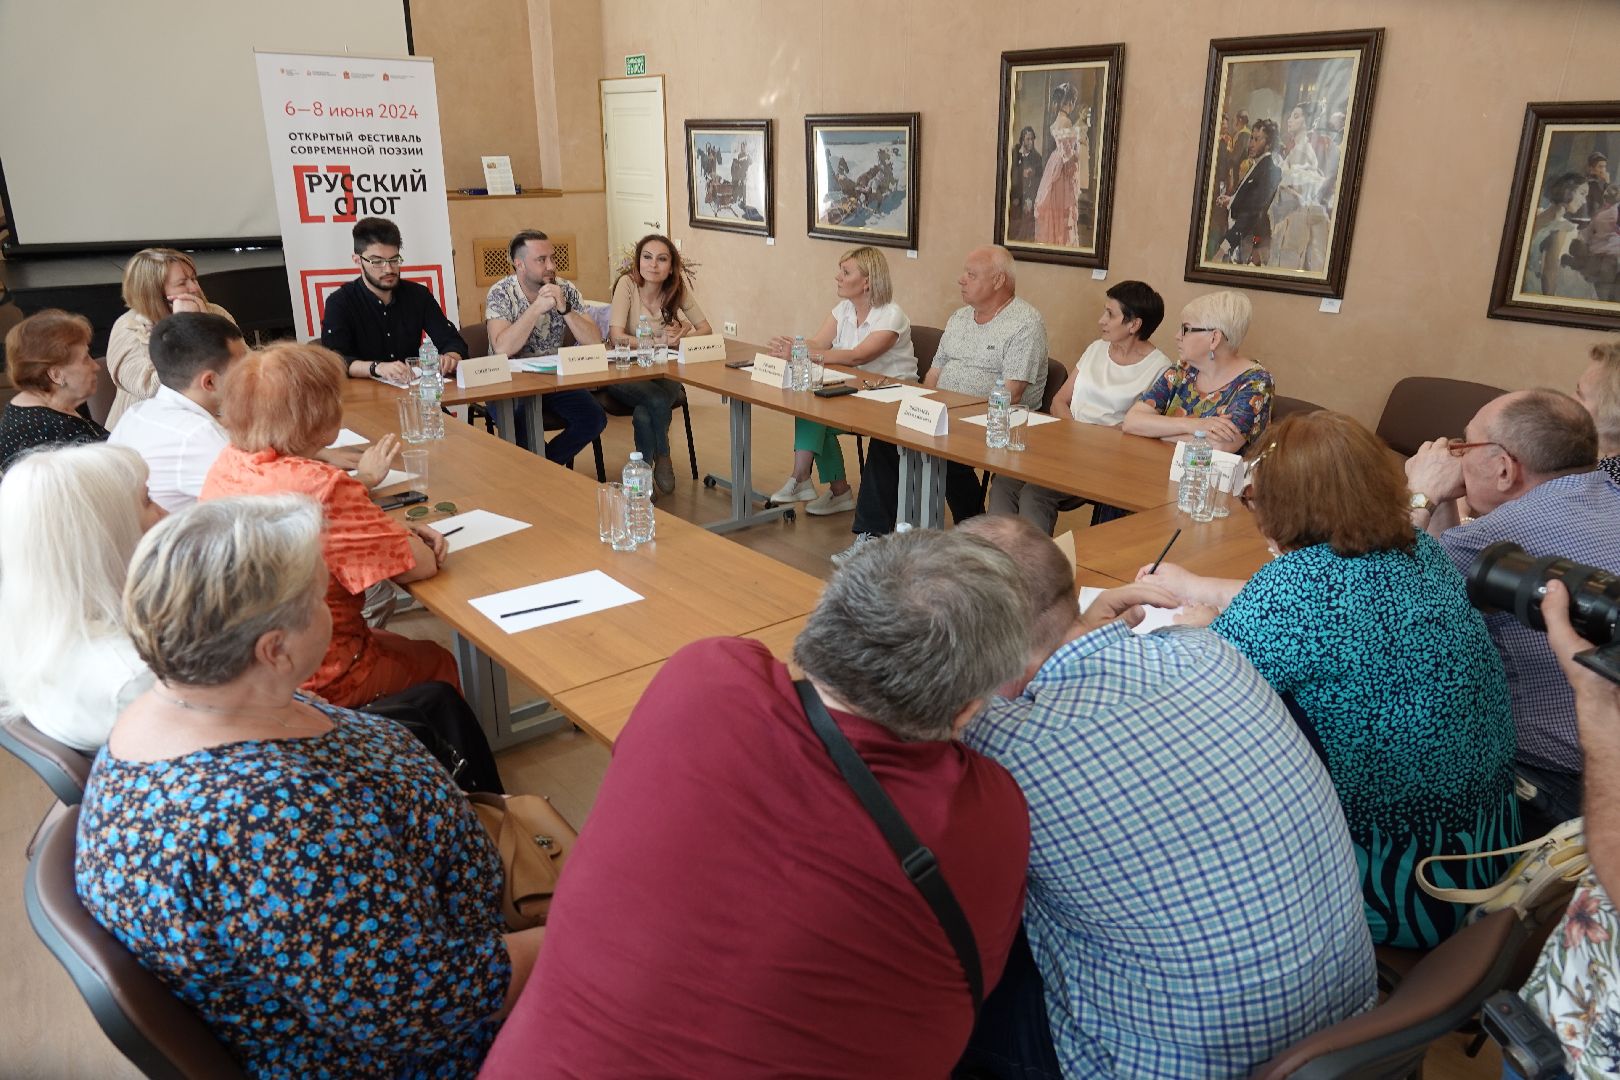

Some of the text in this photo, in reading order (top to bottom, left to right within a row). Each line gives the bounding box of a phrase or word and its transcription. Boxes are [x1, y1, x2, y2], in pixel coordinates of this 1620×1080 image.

[329, 106, 374, 118] июня
[378, 103, 419, 120] 2024
[288, 132, 422, 143] ОТКРЫТЫЙ ФЕСТИВАЛЬ
[290, 144, 424, 156] СОВРЕМЕННОЙ ПОЭЗИИ
[305, 168, 427, 193] РУССКИЙ
[334, 196, 401, 215] СЛОГ
